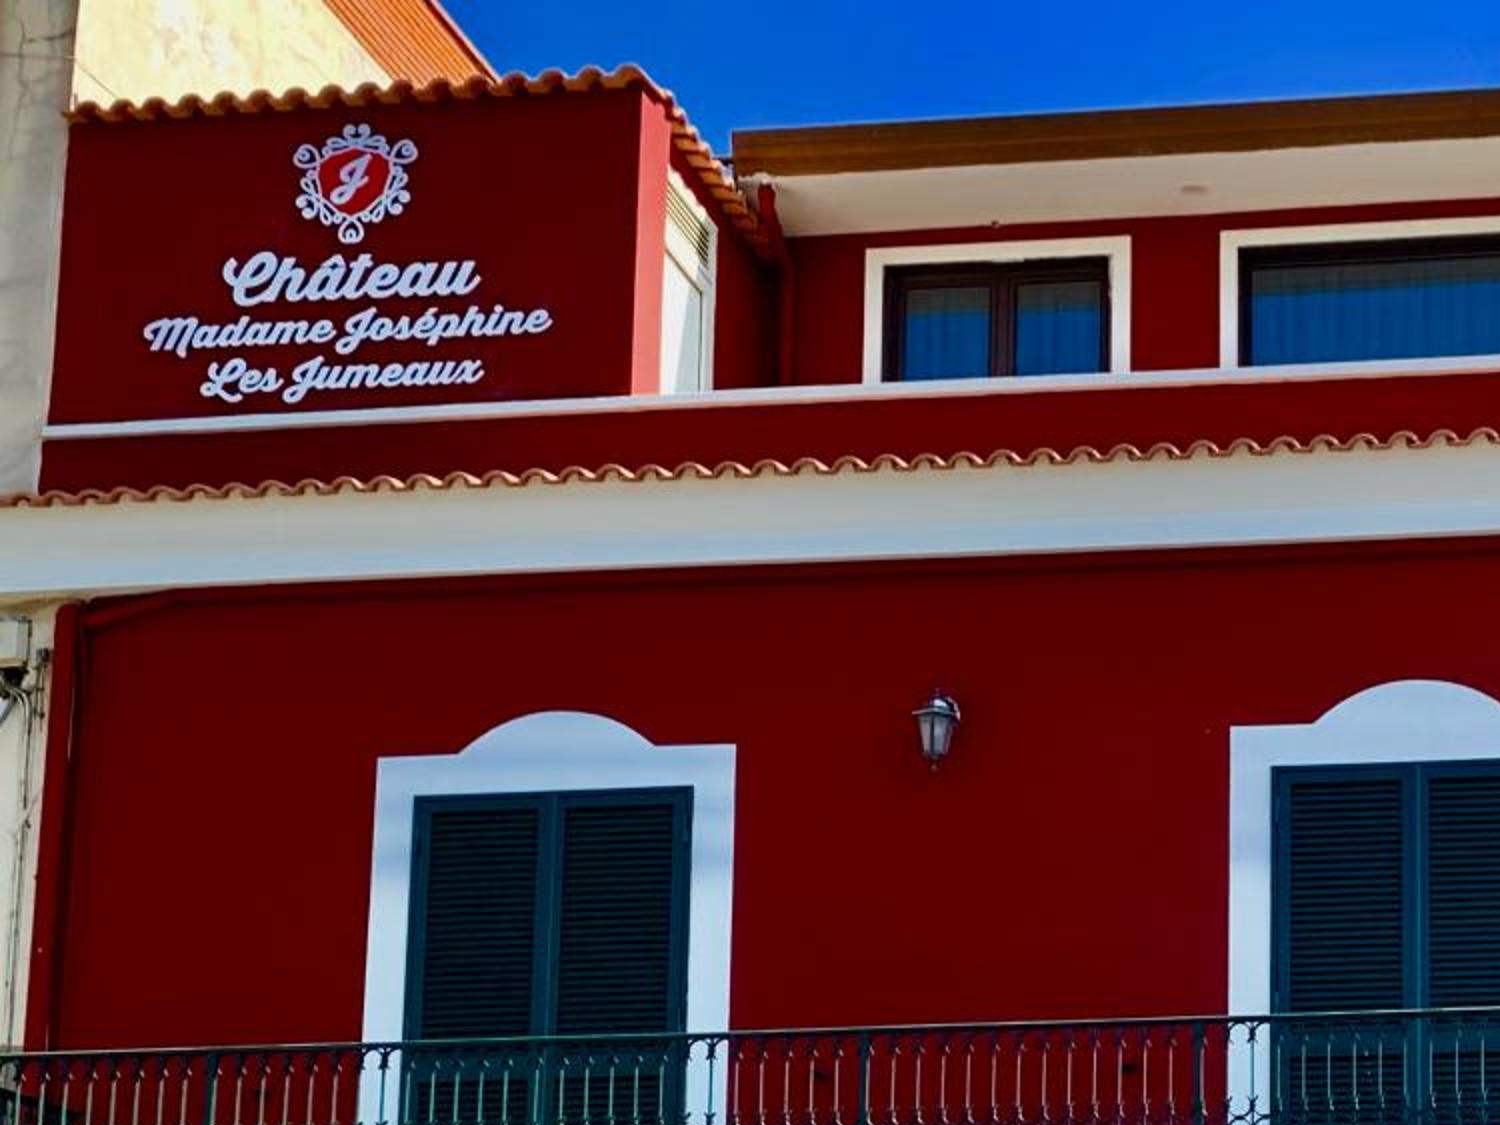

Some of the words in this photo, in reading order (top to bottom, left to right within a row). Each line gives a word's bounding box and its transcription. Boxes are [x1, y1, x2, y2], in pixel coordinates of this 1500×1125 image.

[222, 251, 482, 307] Château
[143, 315, 337, 358] Madame
[335, 304, 553, 355] Joséphine
[200, 357, 284, 402] Les
[282, 355, 485, 404] Jumeaux
